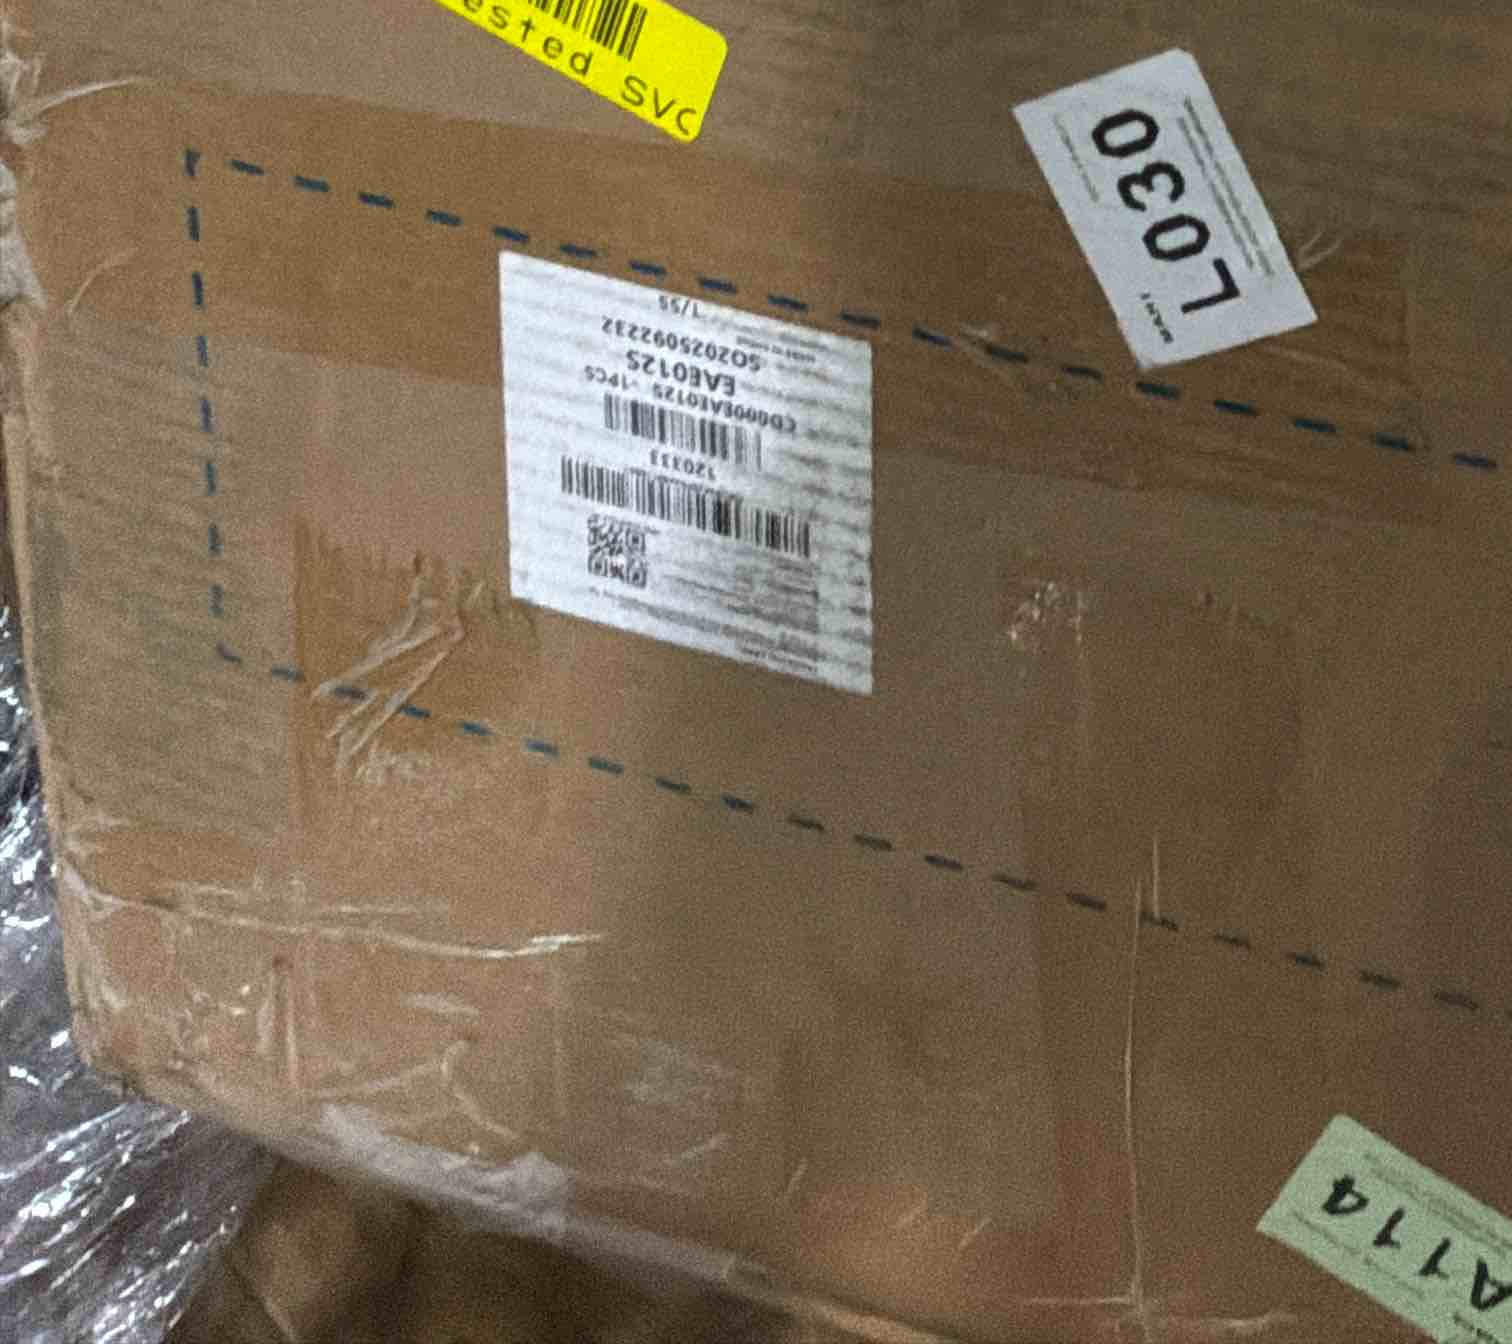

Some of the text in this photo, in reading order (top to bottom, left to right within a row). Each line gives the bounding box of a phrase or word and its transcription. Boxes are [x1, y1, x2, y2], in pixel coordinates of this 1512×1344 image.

[620, 74, 698, 137] SVC
[1090, 106, 1240, 317] L030
[625, 349, 736, 397] EAE012S
